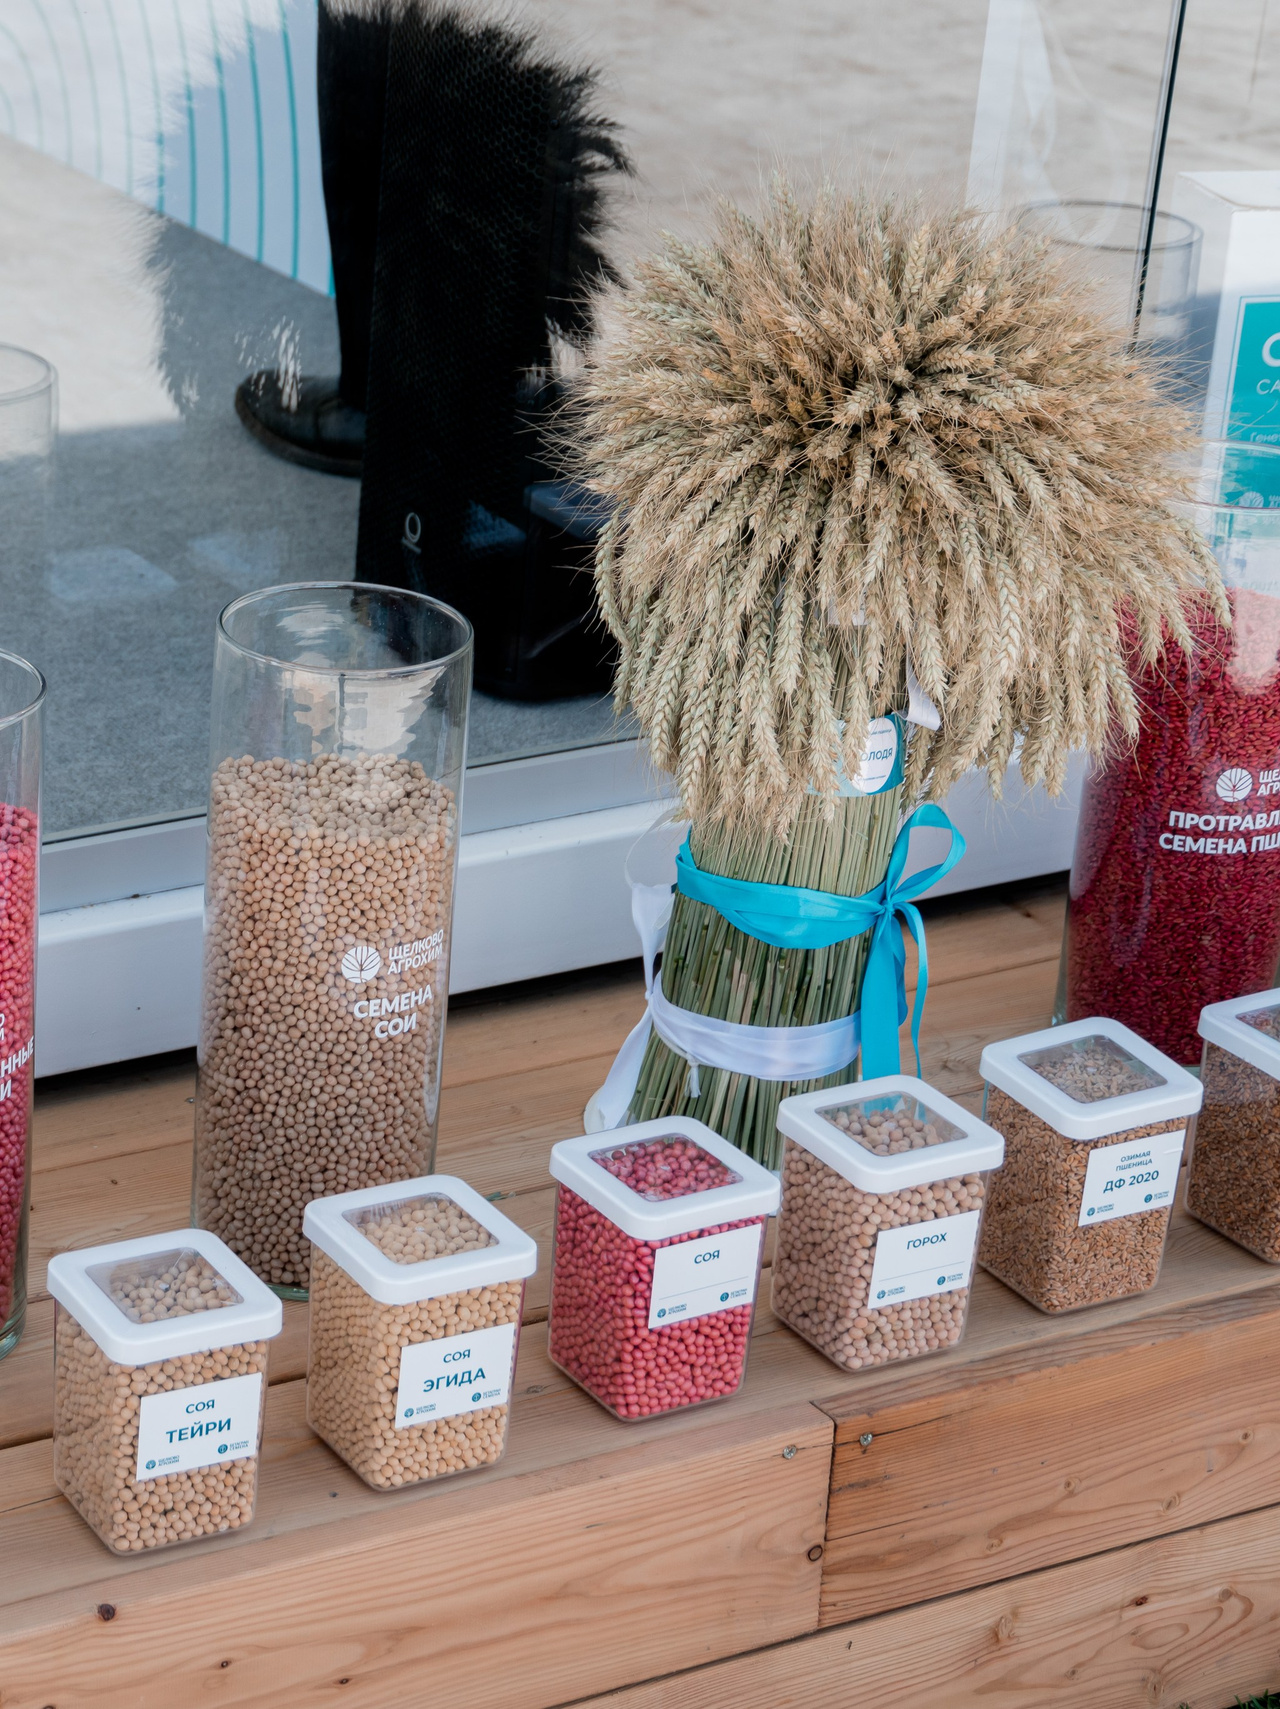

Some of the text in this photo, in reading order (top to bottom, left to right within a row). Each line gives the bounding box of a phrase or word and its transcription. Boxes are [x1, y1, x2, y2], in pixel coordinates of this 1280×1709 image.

[861, 747, 893, 761] ОЛОДЯ
[1159, 832, 1247, 854] СЕМЕНА
[389, 928, 444, 961] ЩЕЛКОВО
[387, 943, 443, 975] АГРОХИМ
[353, 984, 433, 1019] СЕМЕНА
[374, 1012, 417, 1039] СОИ
[1116, 1158, 1153, 1172] ПШЕНИЦА
[1120, 1150, 1151, 1163] ОЗИМАЯ
[1103, 1170, 1160, 1194] ДФ 2020
[907, 1232, 948, 1250] ГОРОХ
[694, 1249, 720, 1264] СОЯ
[443, 1349, 471, 1363] СОЯ
[423, 1367, 486, 1393] ЭГИДА
[185, 1399, 215, 1414] СОЯ
[165, 1417, 232, 1444] ТЕЙРИ
